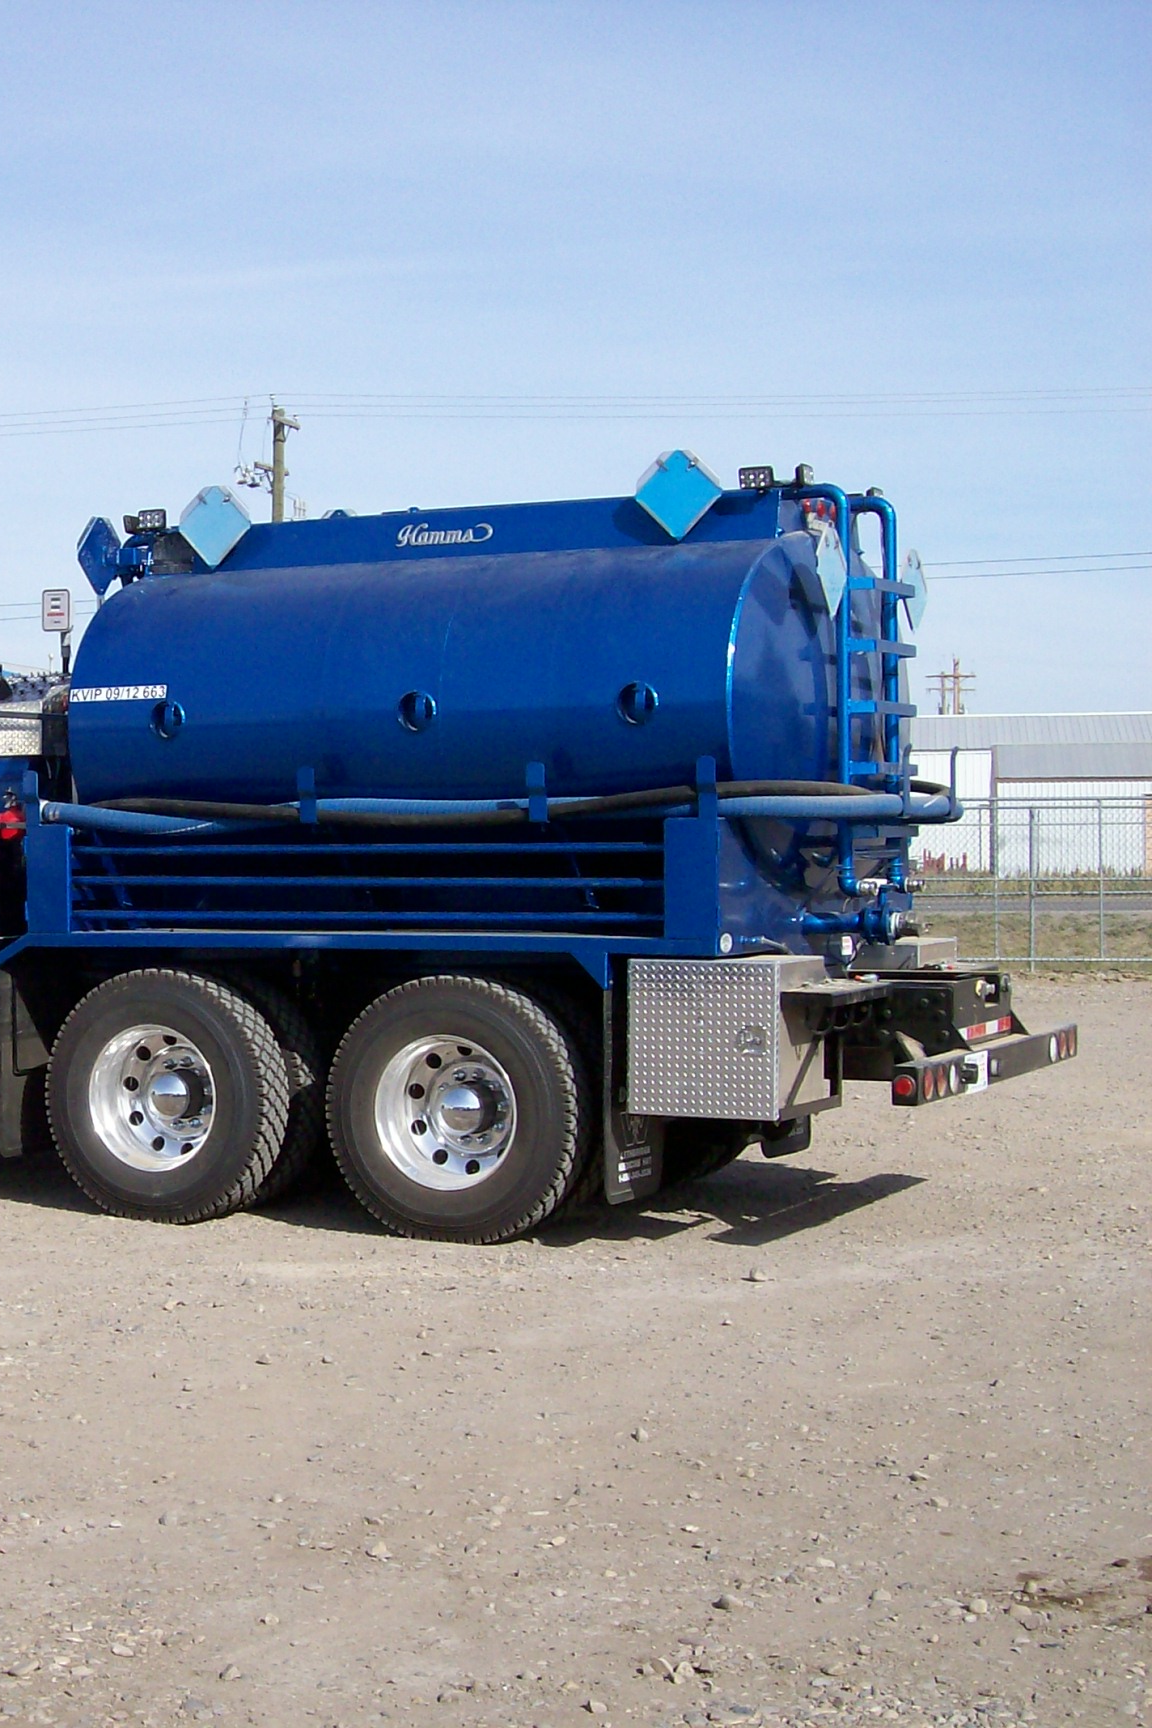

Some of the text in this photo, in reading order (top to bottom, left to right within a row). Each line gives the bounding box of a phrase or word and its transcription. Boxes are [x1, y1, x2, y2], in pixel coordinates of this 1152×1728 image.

[71, 685, 166, 701] KVIP 09/12 663
